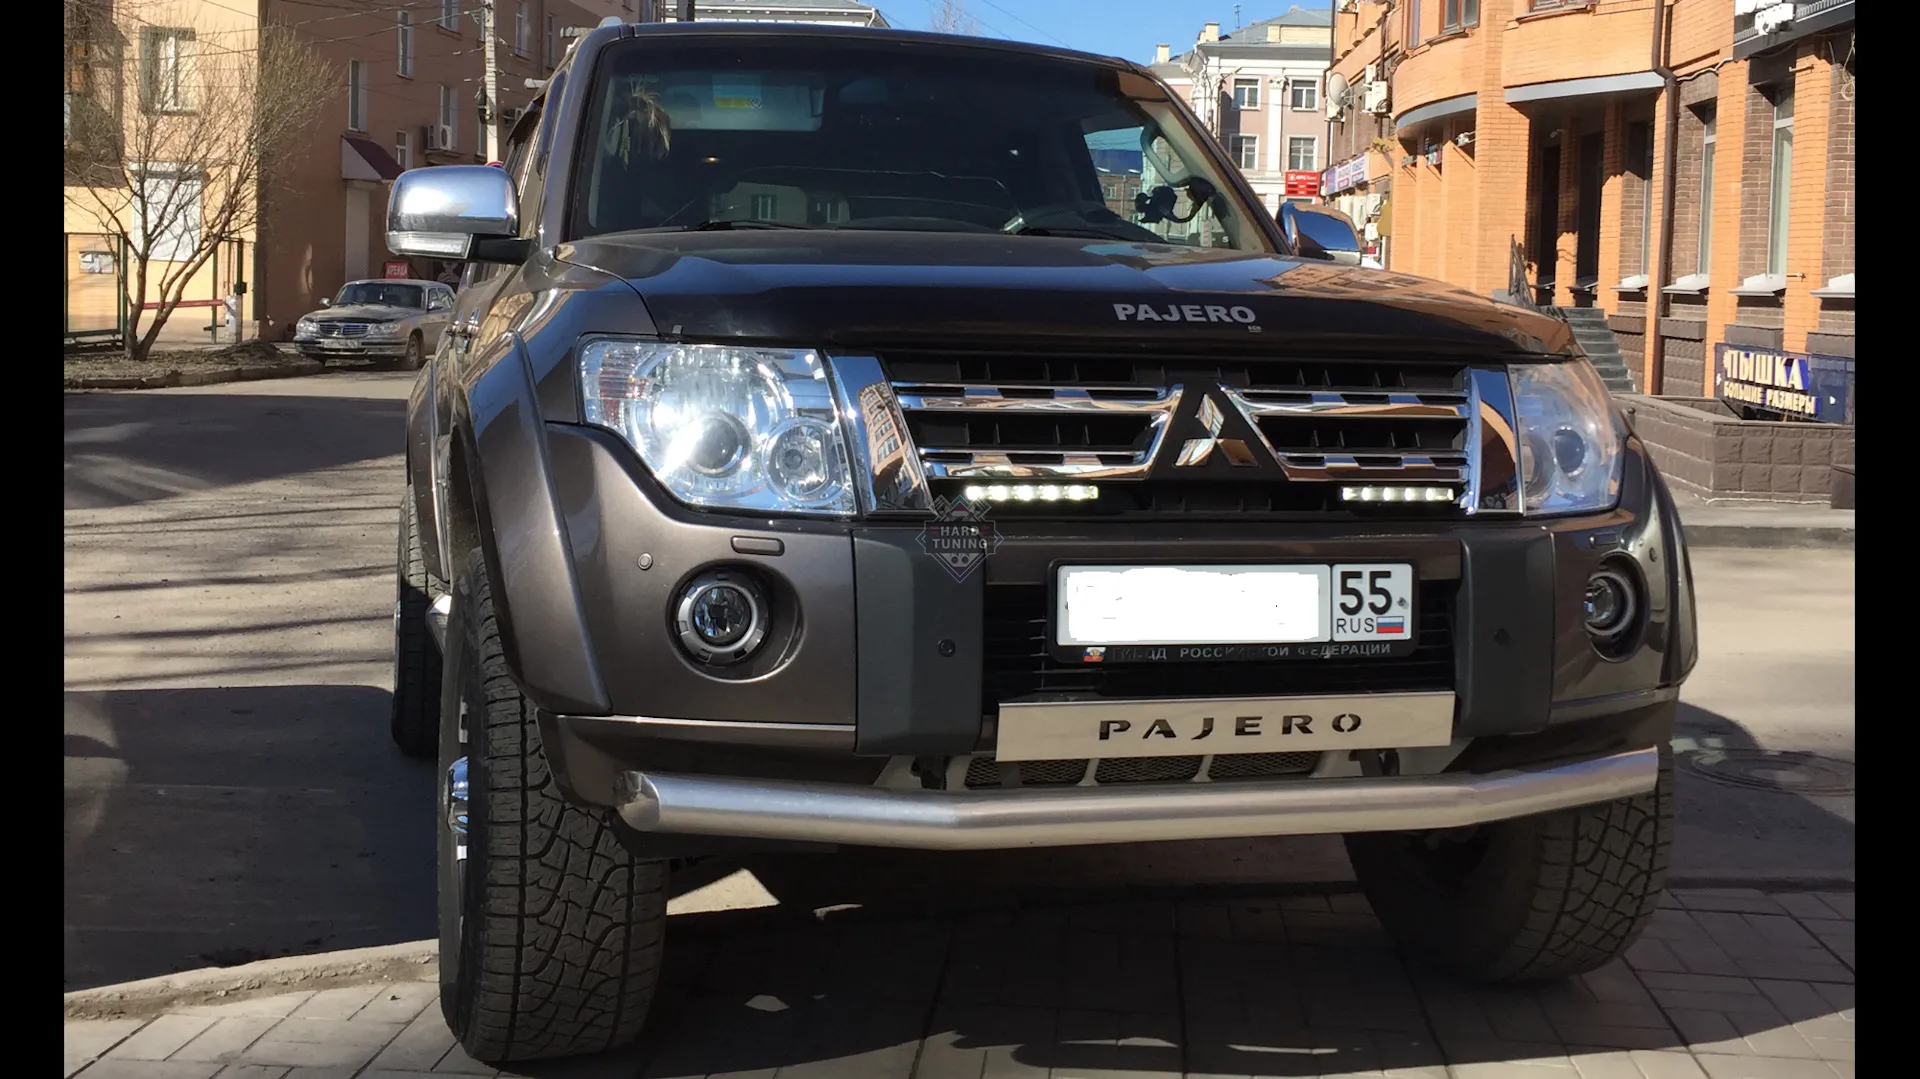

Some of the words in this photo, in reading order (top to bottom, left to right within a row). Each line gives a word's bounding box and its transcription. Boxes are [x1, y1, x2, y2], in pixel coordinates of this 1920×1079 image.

[1113, 303, 1256, 323] PAJERO
[1726, 350, 1803, 390] ПЫШКА
[1723, 381, 1764, 404] БОЛЬШИЕ
[1766, 389, 1816, 415] РАЗМЕРЫ
[1339, 571, 1393, 616] 55
[1336, 617, 1375, 634] RUS
[1099, 713, 1362, 741] PAJERO
